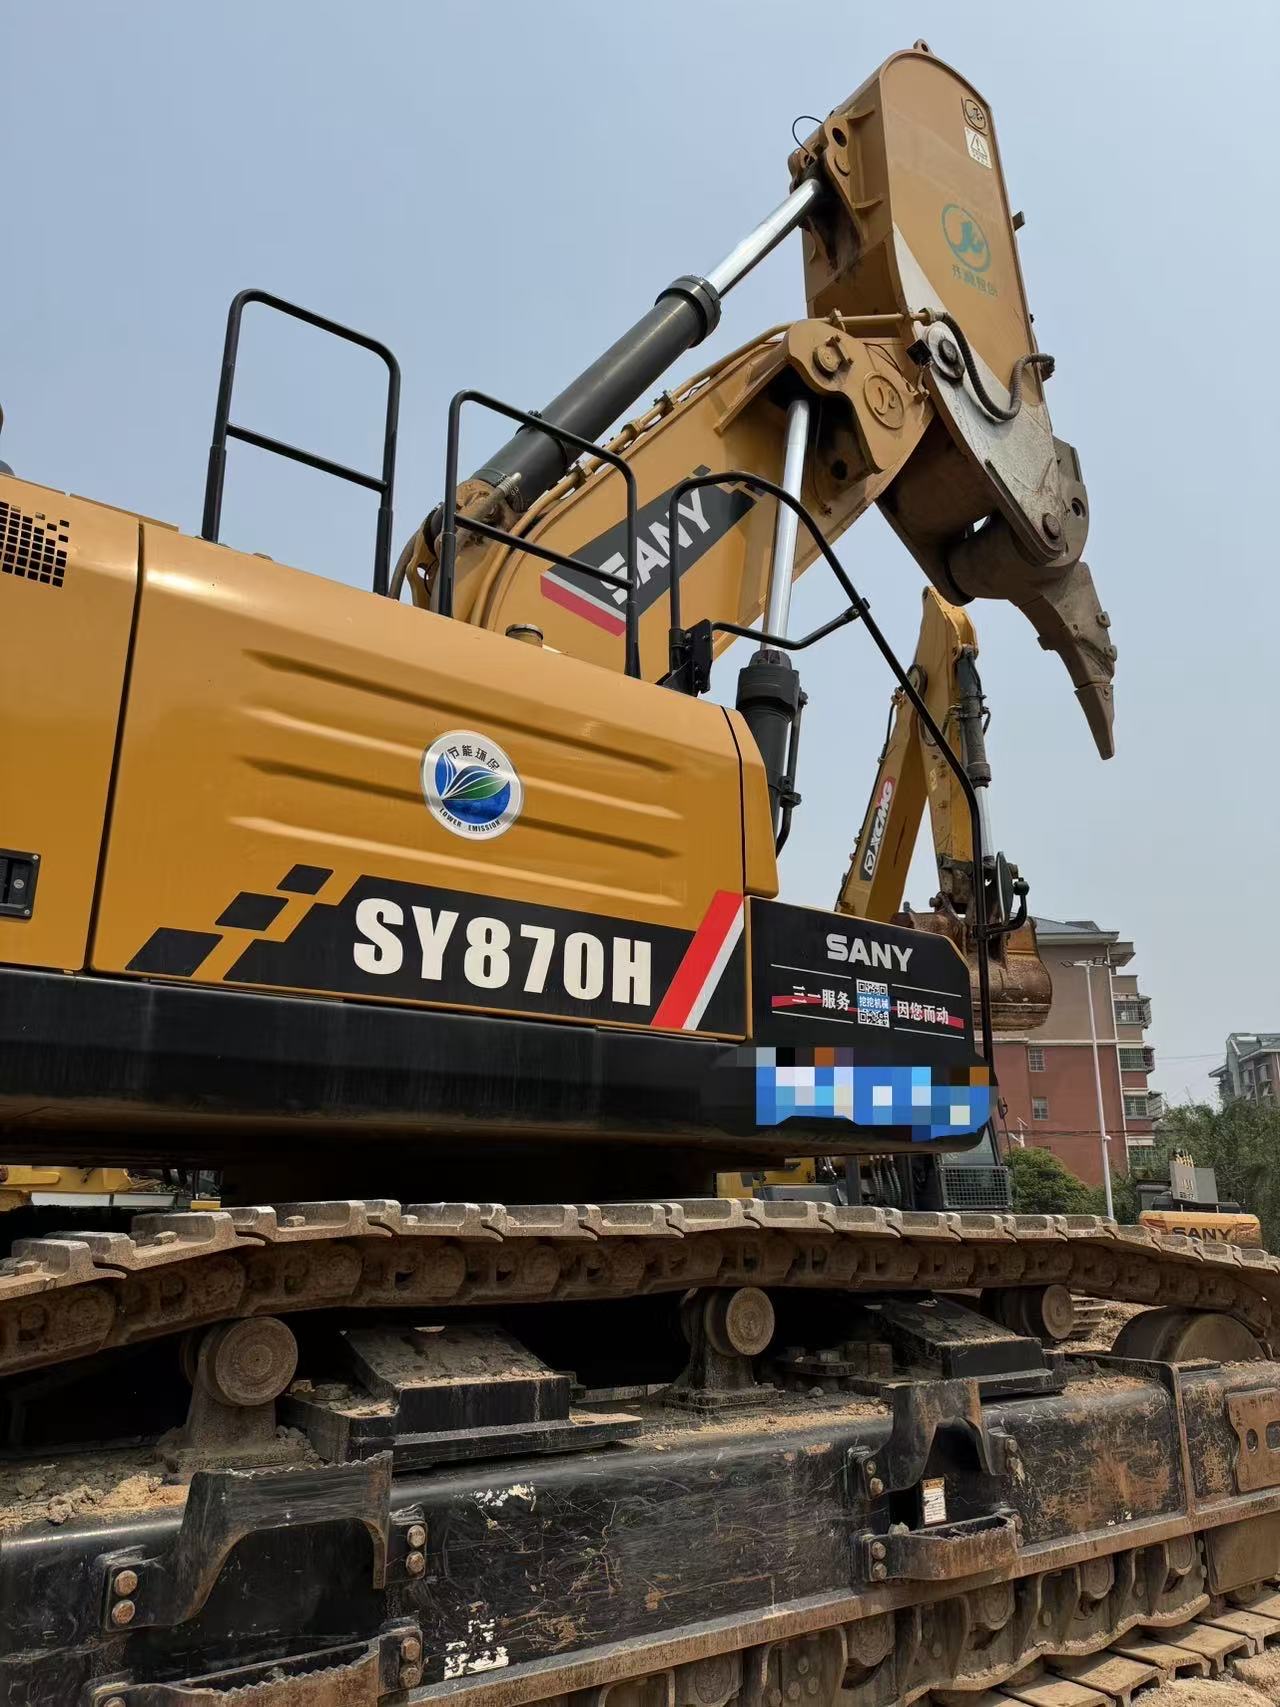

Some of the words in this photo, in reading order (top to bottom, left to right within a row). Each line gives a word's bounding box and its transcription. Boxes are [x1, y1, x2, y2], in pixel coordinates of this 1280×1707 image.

[600, 488, 711, 605] SANY
[447, 745, 500, 771] 节能环保
[439, 807, 462, 828] LOWER
[468, 819, 501, 832] EMISSION
[353, 897, 652, 1006] SY870H
[825, 933, 913, 973] SANY
[792, 985, 850, 1011] 三一服务
[896, 1000, 949, 1025] 因您而动
[1172, 1226, 1231, 1241] SANY
